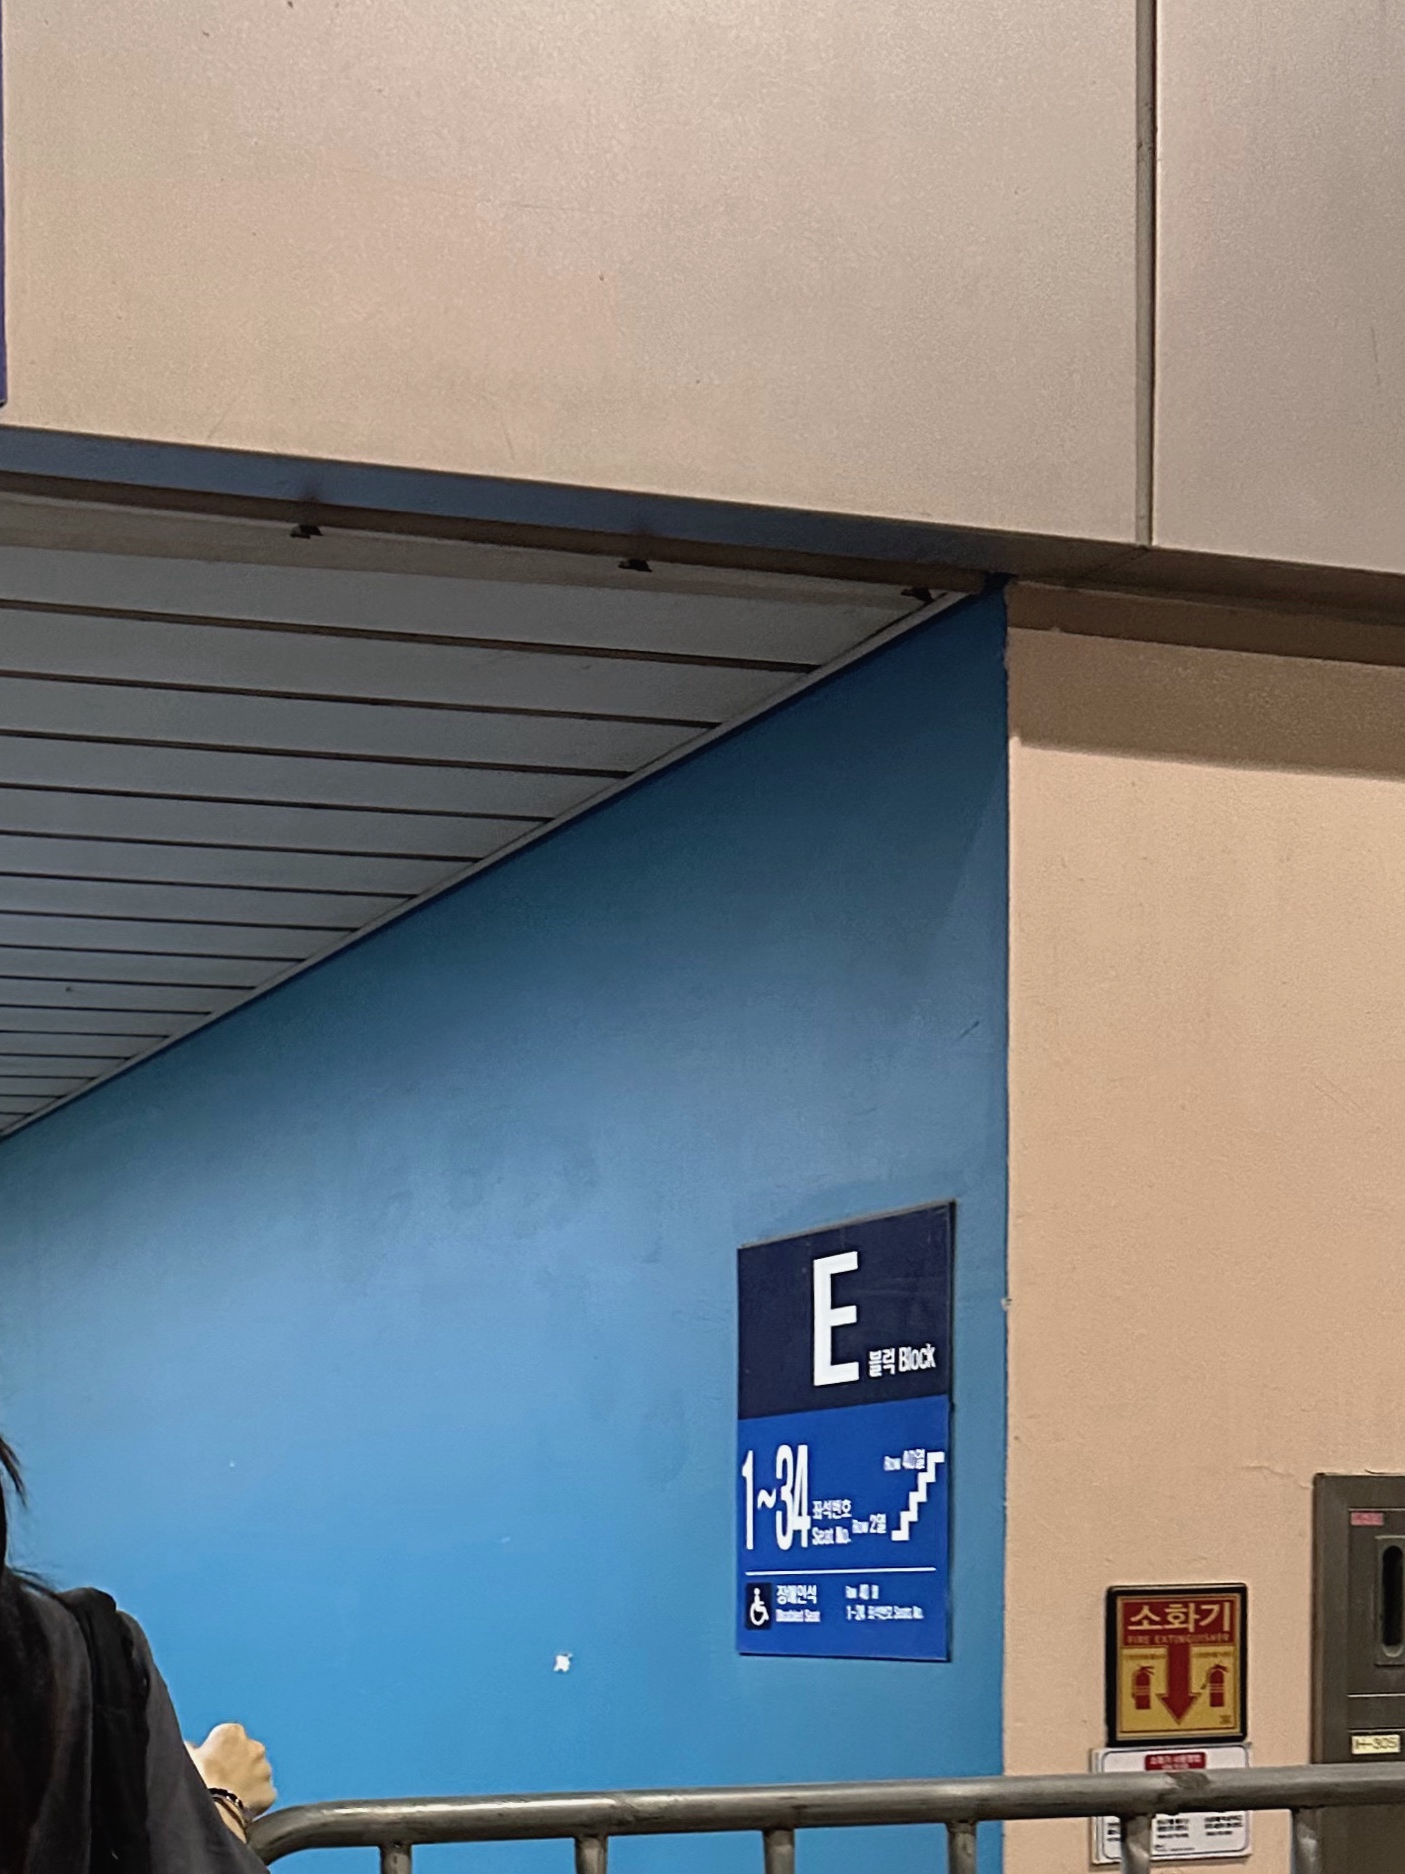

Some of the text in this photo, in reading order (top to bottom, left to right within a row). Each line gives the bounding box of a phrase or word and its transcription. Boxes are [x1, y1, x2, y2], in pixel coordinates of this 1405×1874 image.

[813, 1251, 936, 1387] E 블럭 Block
[1127, 1601, 1231, 1633] 소화기
